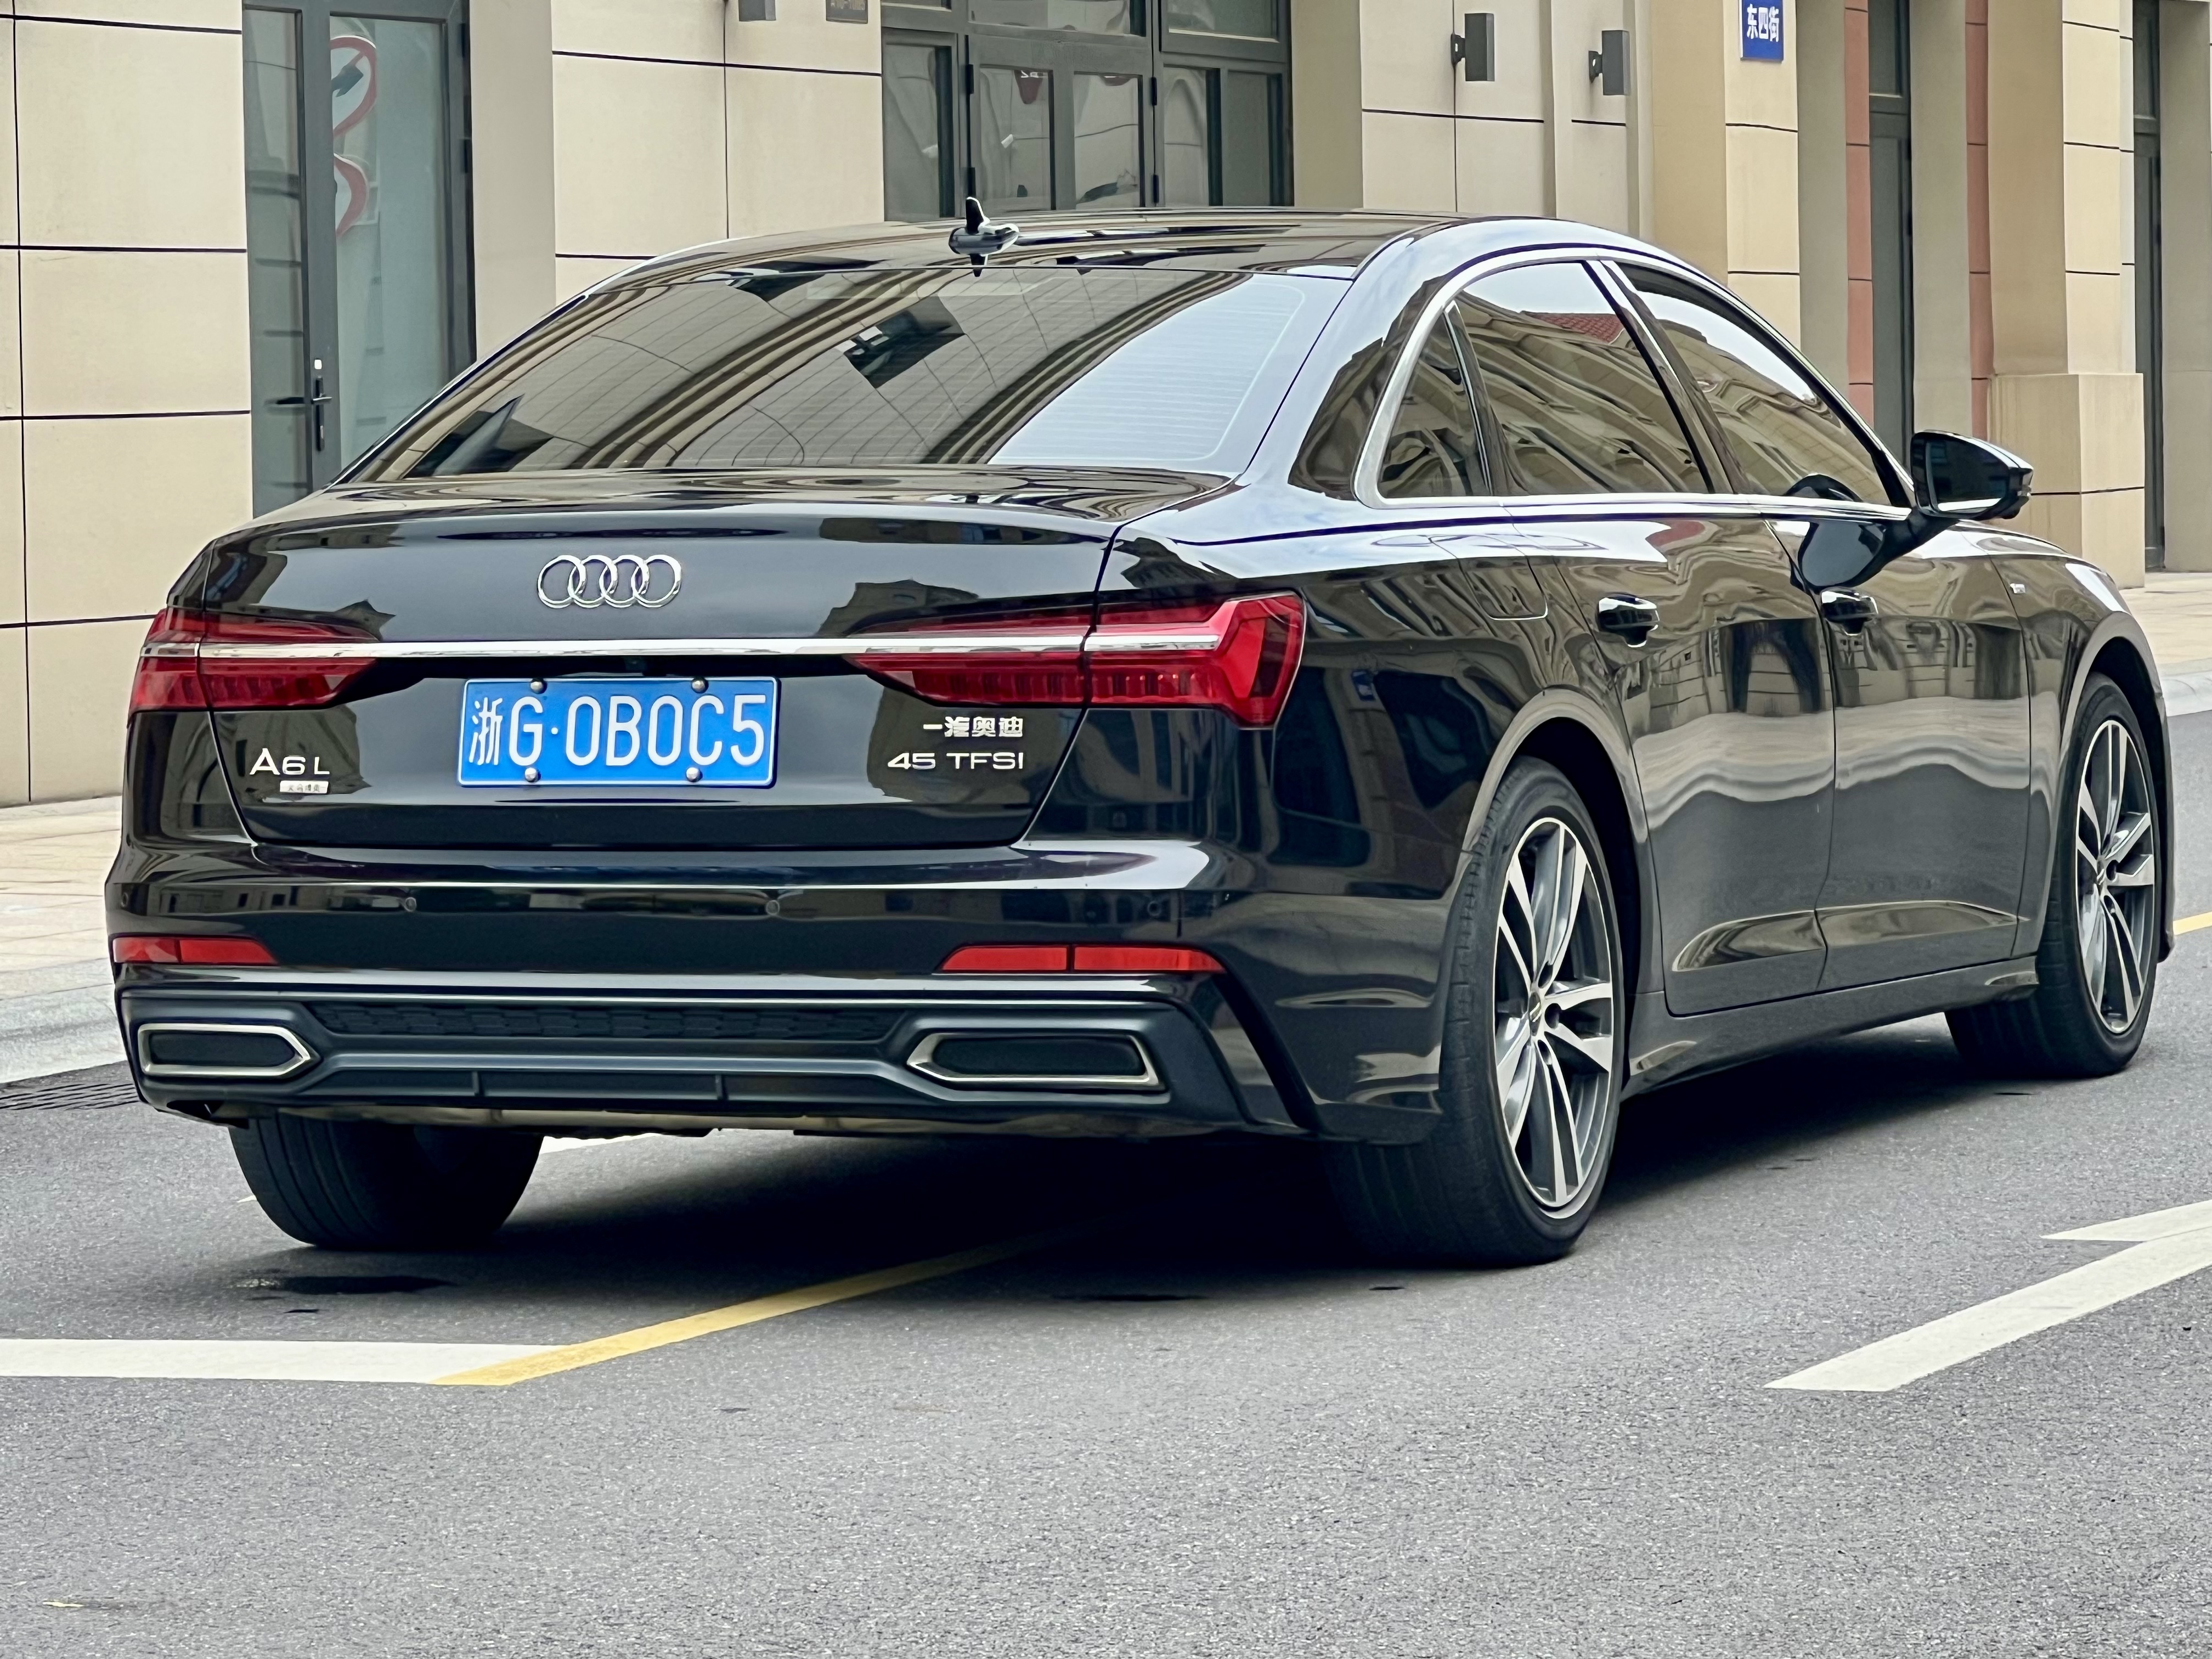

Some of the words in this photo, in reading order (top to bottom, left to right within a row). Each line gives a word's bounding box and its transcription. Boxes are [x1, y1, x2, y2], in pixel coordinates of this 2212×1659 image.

[923, 716, 1023, 737] 一汽奥迪
[888, 752, 936, 769] 45
[946, 752, 1024, 769] TFSI
